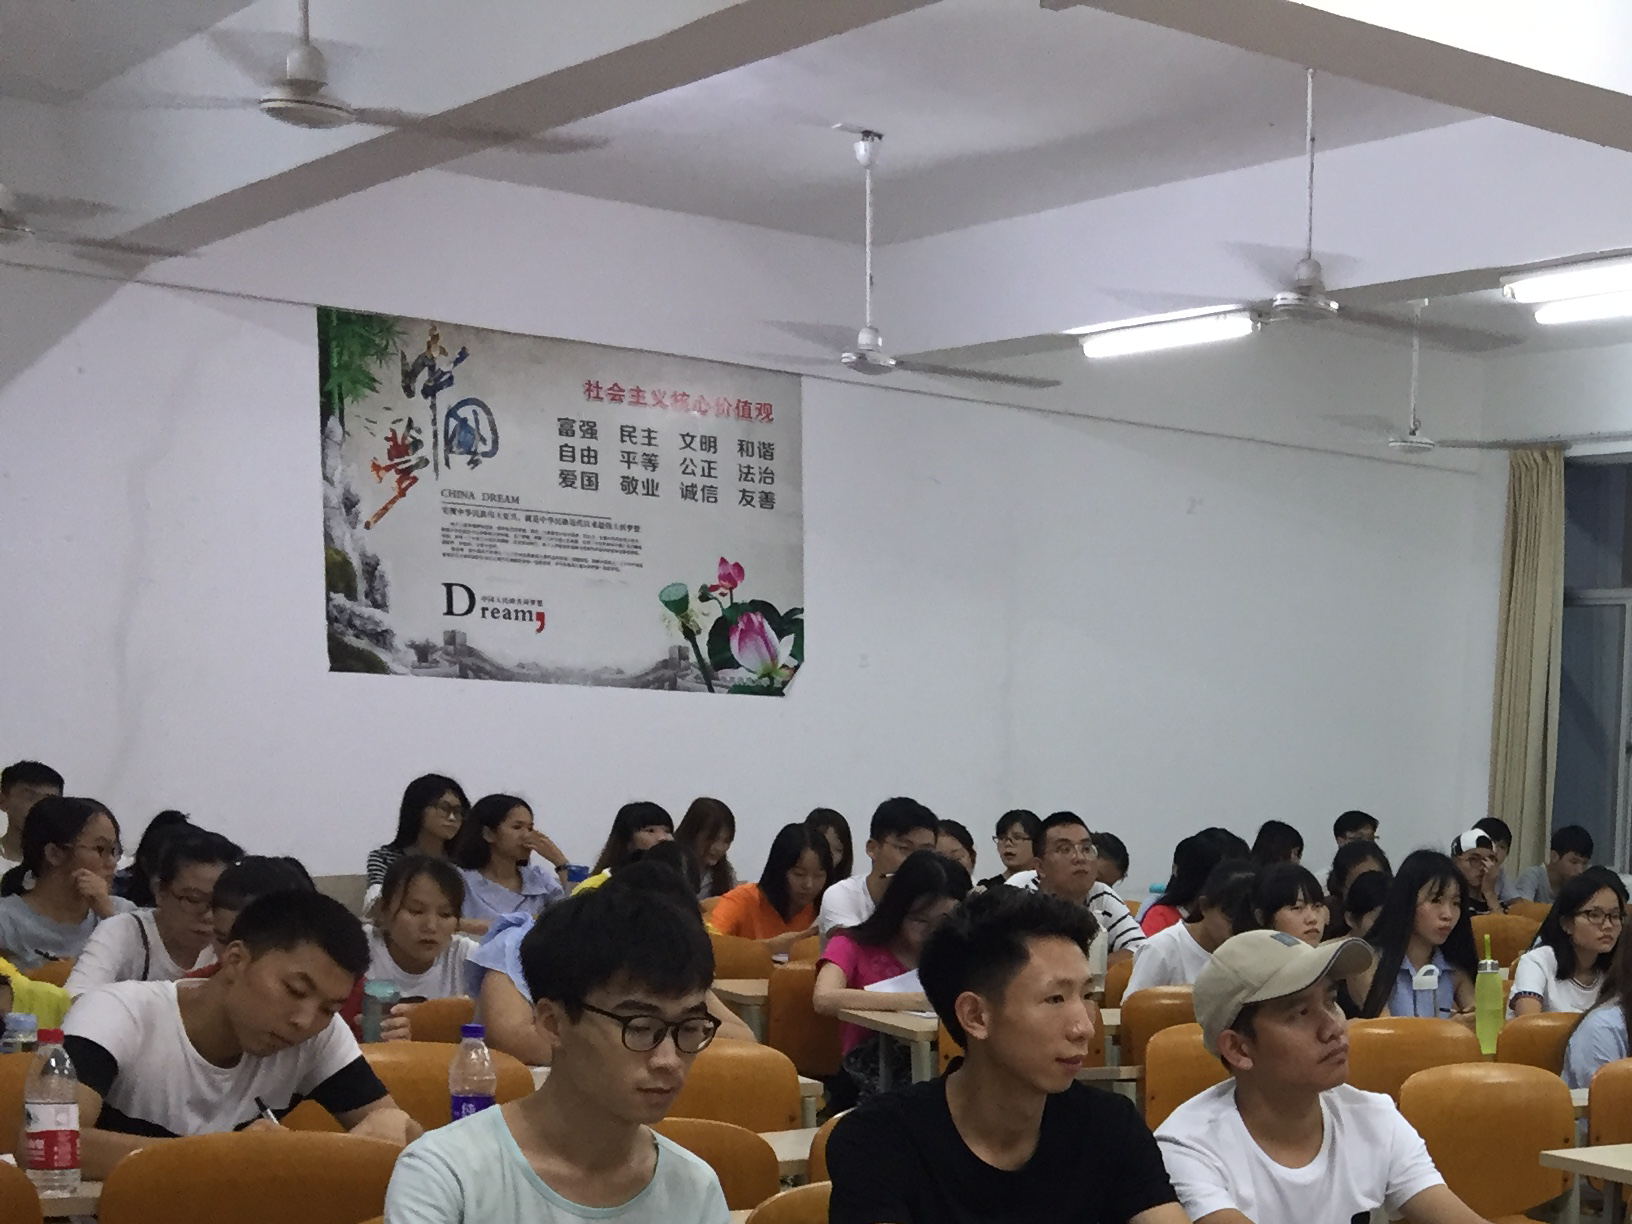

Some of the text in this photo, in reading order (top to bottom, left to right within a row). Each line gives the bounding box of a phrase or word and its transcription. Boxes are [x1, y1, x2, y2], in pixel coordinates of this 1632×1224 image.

[584, 379, 775, 424] 社会主义核心价值观
[557, 416, 775, 462] 富强 民主 文明 和谐
[558, 443, 775, 486] 自由 平等 公正 法治
[440, 488, 520, 504] CHINA DREAM
[558, 469, 776, 511] 爱国 敬业 诚信 友善
